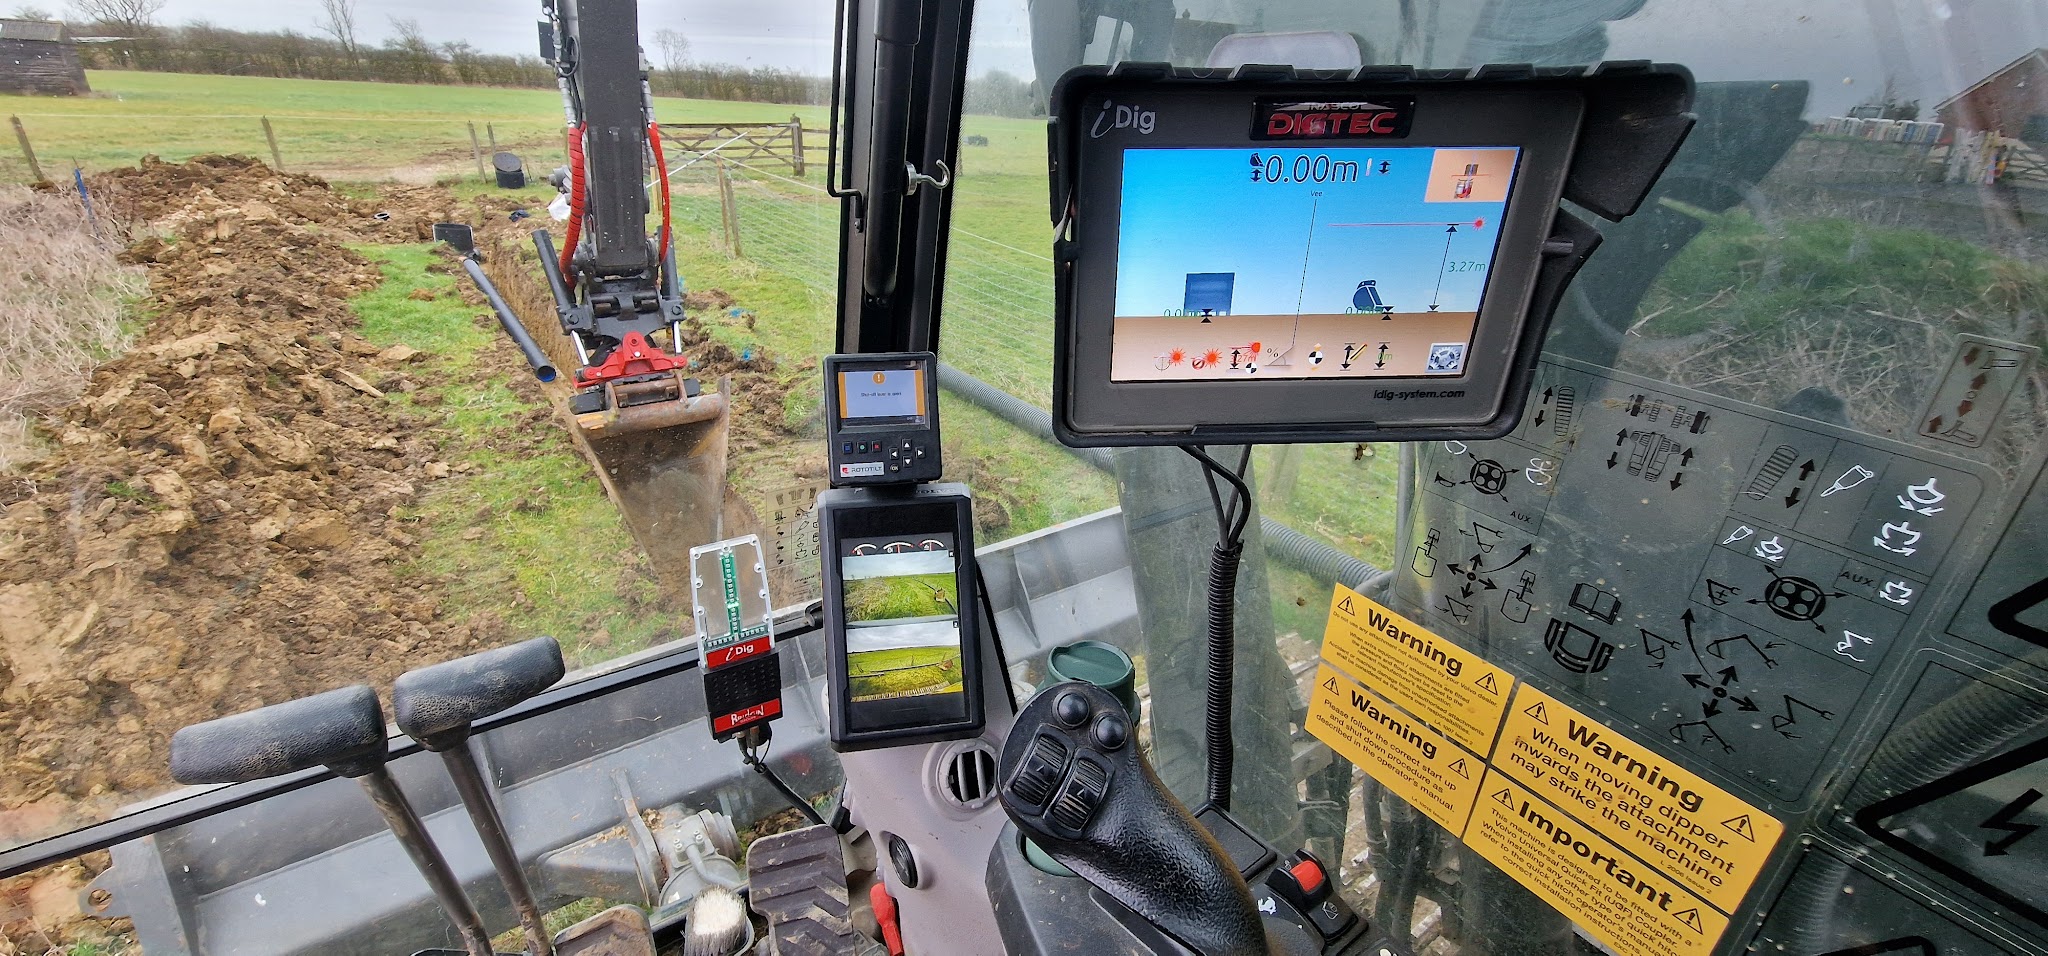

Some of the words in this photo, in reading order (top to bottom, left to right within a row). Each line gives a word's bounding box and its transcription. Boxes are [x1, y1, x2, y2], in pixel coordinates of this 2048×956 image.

[1265, 154, 1359, 184] 0.00m
[1267, 112, 1398, 135] DIGTEC
[1448, 261, 1486, 273] 3.27m
[1368, 607, 1463, 677] Warning
[1316, 714, 1353, 742] described
[1362, 744, 1376, 758] the
[1376, 756, 1419, 788] operator's
[1420, 785, 1455, 813] manual.
[1324, 698, 1349, 720] Please
[1350, 716, 1374, 736] follow
[1375, 732, 1389, 746] the
[1389, 744, 1421, 767] correct
[1421, 764, 1443, 782] start
[1444, 779, 1457, 791] up
[1329, 713, 1345, 727] and
[1345, 724, 1363, 739] shut
[1363, 736, 1386, 755] down
[1386, 752, 1431, 785] procedure
[1432, 782, 1444, 794] as
[1351, 689, 1438, 760] Warning
[1568, 718, 1704, 813] Warning
[1510, 752, 1546, 779] may
[1548, 776, 1601, 810] strike
[1601, 806, 1631, 831] the
[1635, 829, 1723, 887] machine
[1514, 735, 1580, 782] inwards
[1584, 777, 1613, 804] the
[1617, 797, 1735, 875] attachment
[1532, 727, 1580, 765] When
[1583, 761, 1654, 809] moving
[1658, 805, 1729, 849] dipper
[1480, 830, 1500, 845] refer
[1510, 850, 1525, 863] the
[1525, 861, 1551, 882] quick
[1551, 878, 1575, 898] hitch
[1575, 896, 1625, 933] operator's
[1482, 820, 1506, 841] When
[1506, 837, 1545, 869] installing
[1546, 866, 1564, 880] any
[1564, 878, 1590, 897] other
[1590, 895, 1613, 914] type
[1614, 913, 1626, 923] of
[1626, 921, 1657, 944] quick
[1656, 941, 1682, 956] hitc
[1491, 807, 1508, 824] This
[1509, 821, 1547, 849] machine
[1557, 853, 1602, 886] designed
[1602, 882, 1613, 894] to
[1614, 890, 1629, 904] be
[1630, 901, 1658, 923] fitted
[1660, 921, 1683, 941] with
[1495, 819, 1517, 839] Volvo
[1518, 836, 1560, 868] Universal
[1560, 865, 1588, 887] Quick
[1589, 884, 1603, 898] Fit
[1634, 915, 1678, 949] Coupler.
[1502, 855, 1533, 879] correct
[1533, 875, 1582, 913] installation
[1518, 800, 1673, 913] Important
